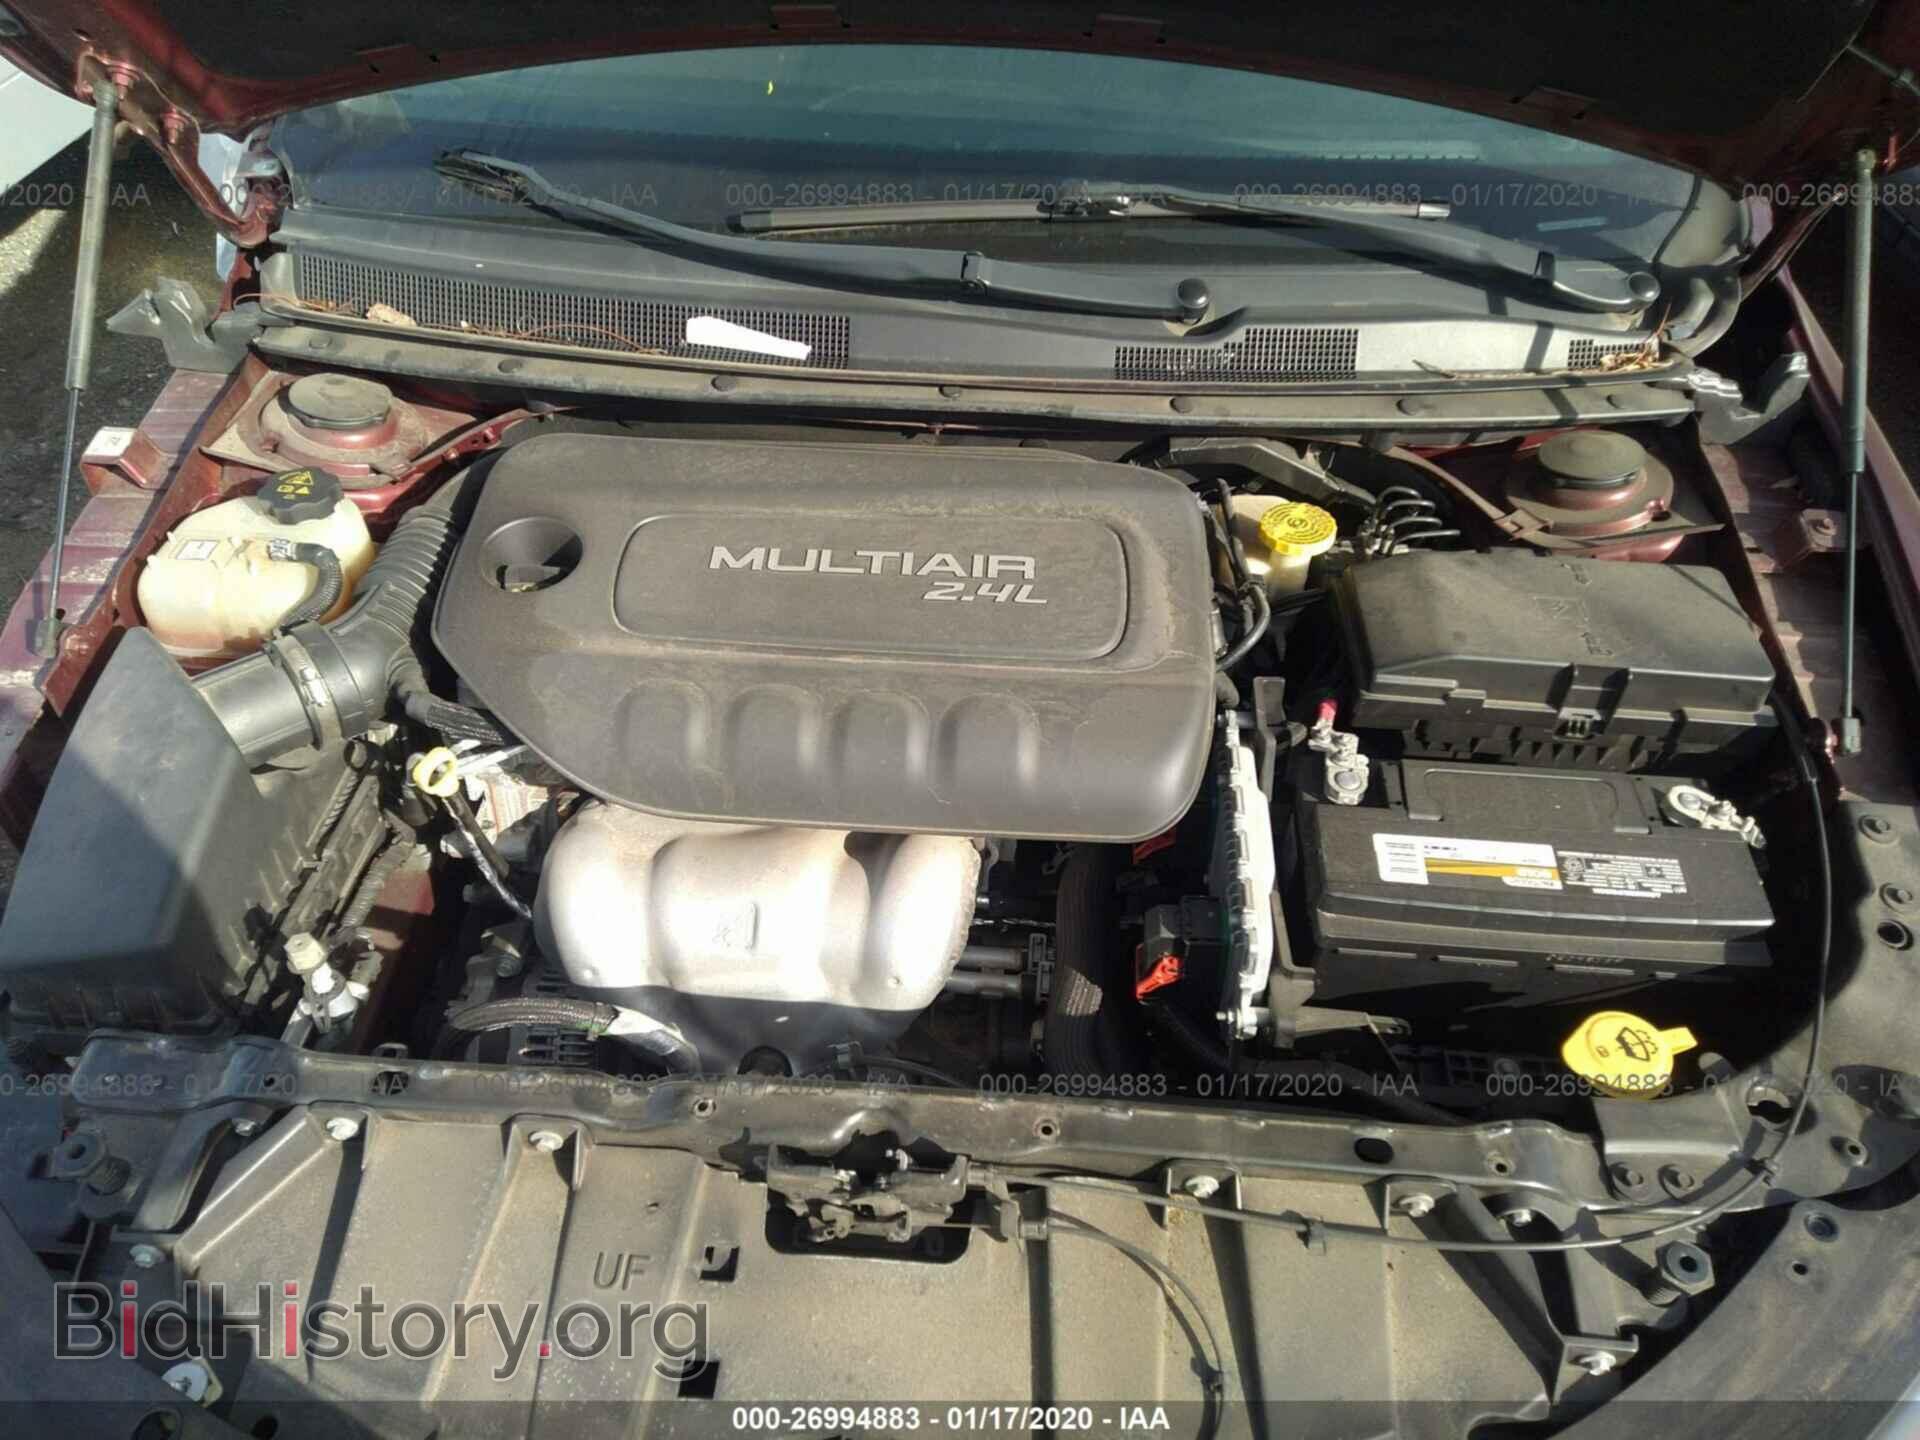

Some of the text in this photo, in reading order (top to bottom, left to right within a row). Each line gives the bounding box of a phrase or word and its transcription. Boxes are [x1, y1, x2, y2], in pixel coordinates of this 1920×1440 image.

[709, 546, 1036, 580] MULTIAIR
[922, 581, 1048, 604] 2.4L
[593, 1251, 651, 1291] UF
